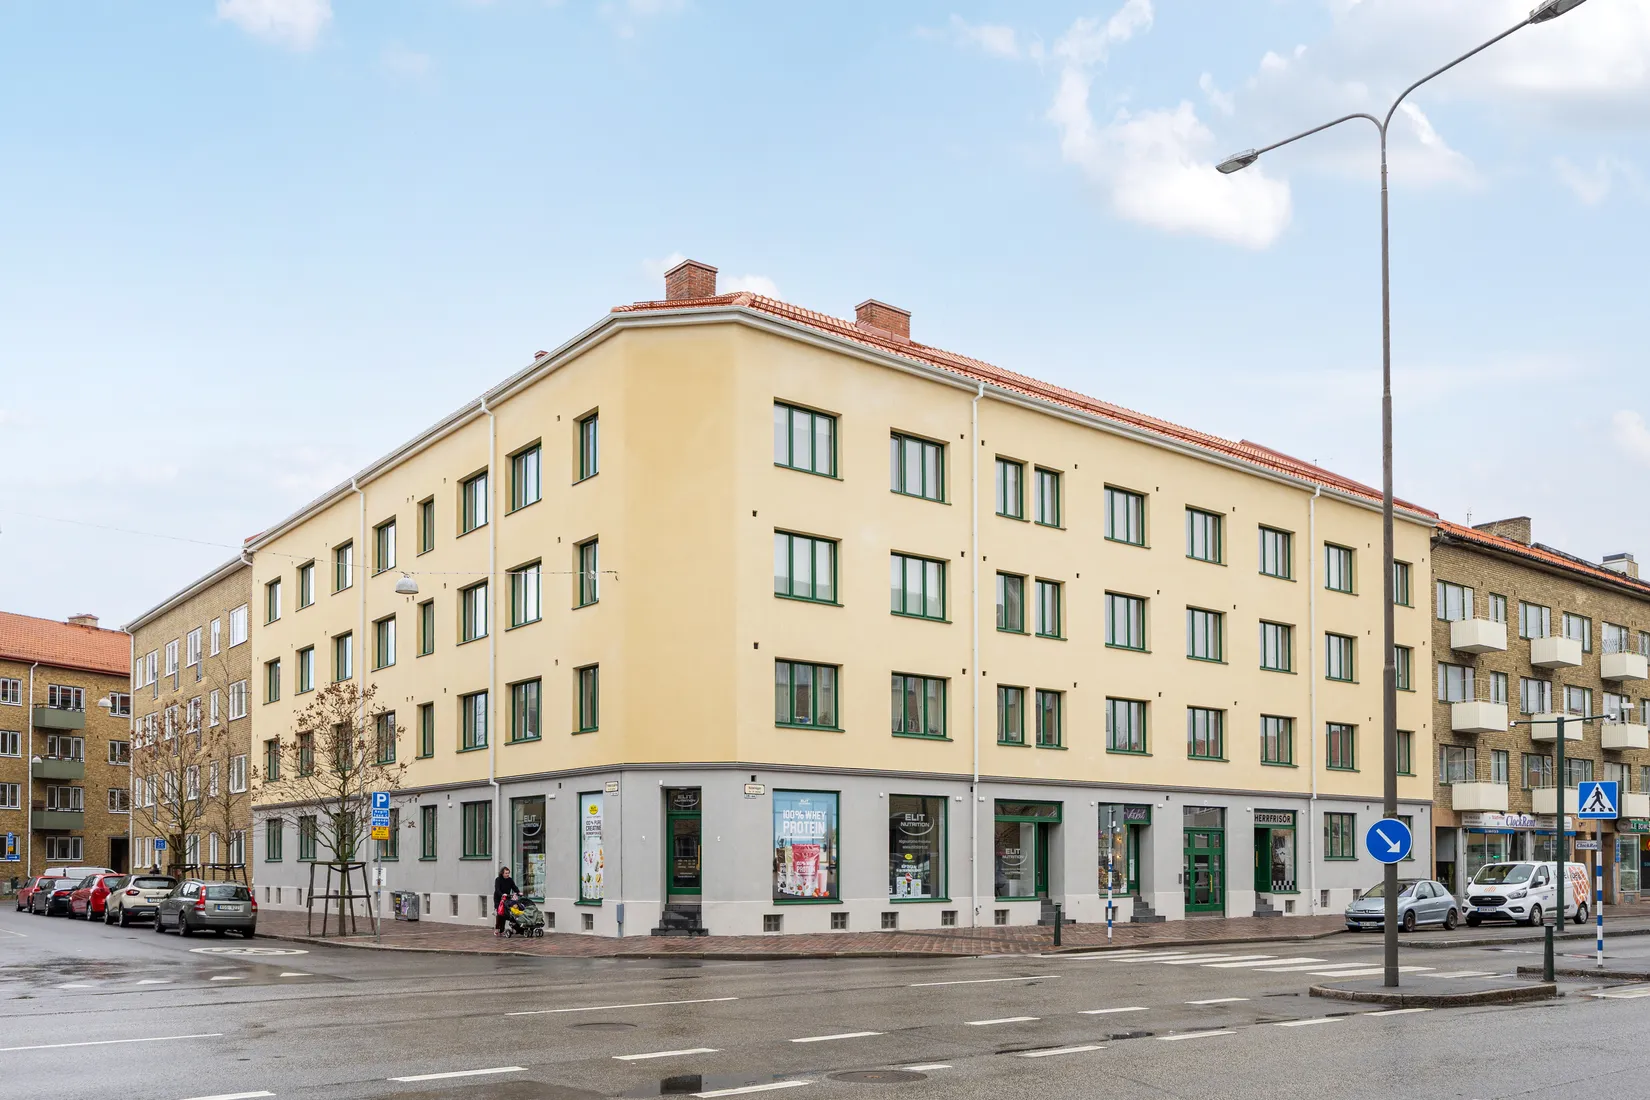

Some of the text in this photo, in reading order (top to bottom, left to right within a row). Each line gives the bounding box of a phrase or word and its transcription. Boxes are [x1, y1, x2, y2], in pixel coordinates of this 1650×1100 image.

[376, 793, 387, 807] P
[782, 810, 827, 820] 100% WHEY
[1254, 814, 1291, 823] HERRFRISÖR
[1505, 815, 1536, 827] ClockRent
[783, 821, 825, 834] PROTEIN
